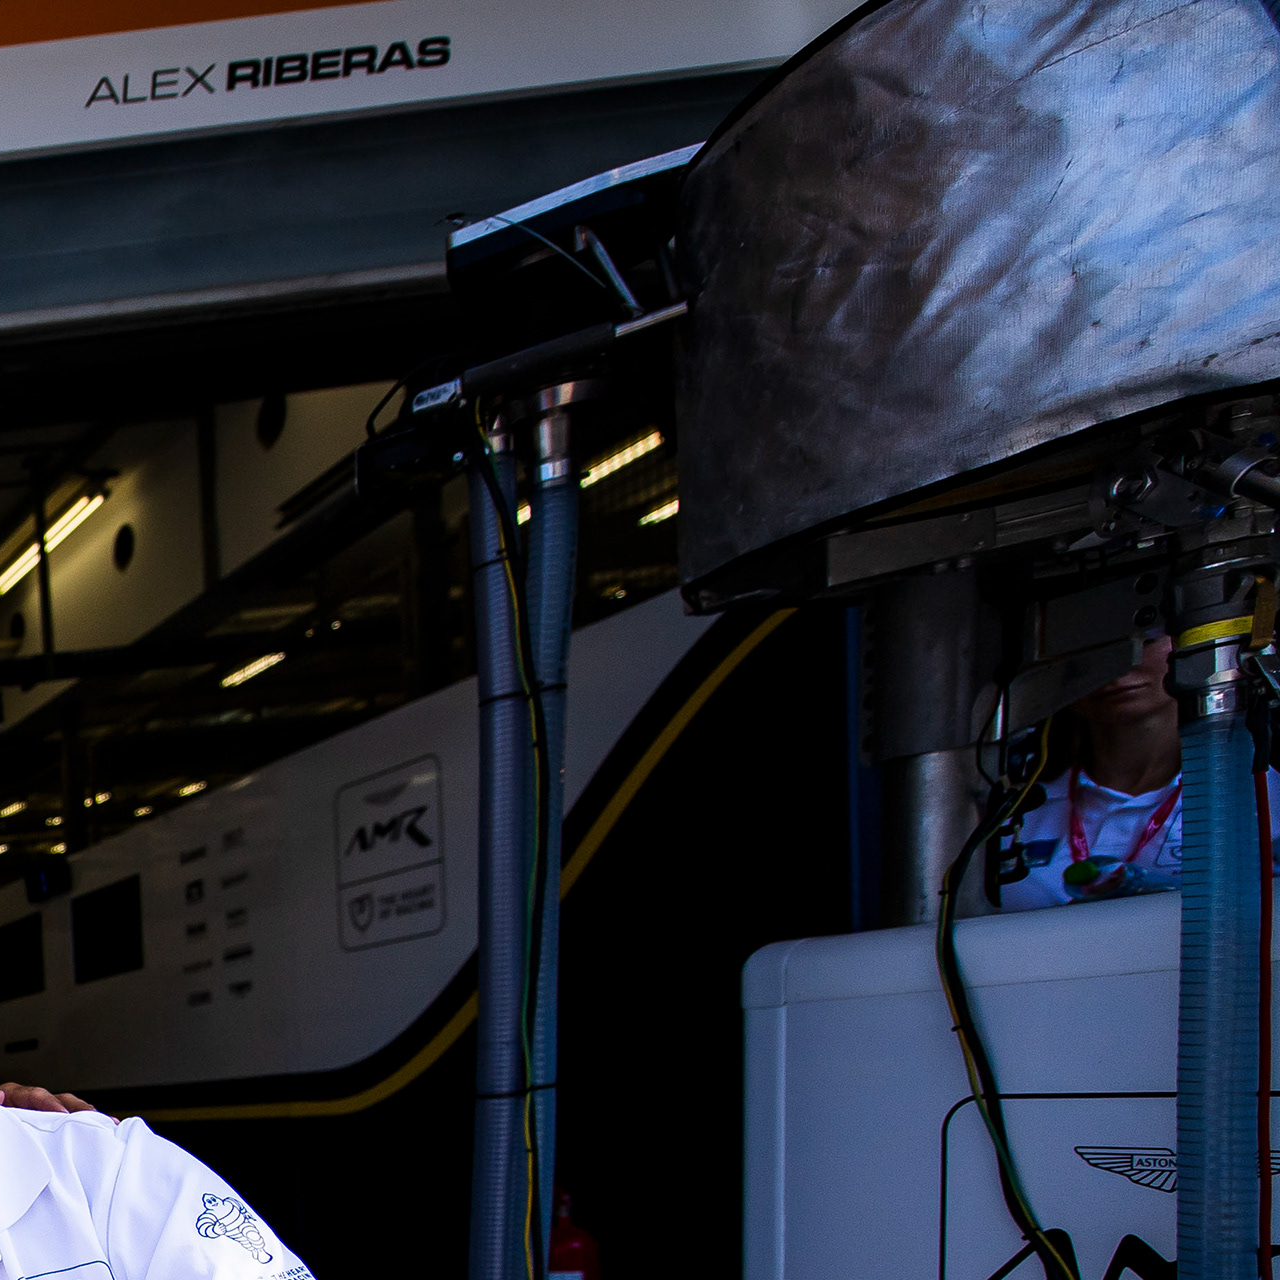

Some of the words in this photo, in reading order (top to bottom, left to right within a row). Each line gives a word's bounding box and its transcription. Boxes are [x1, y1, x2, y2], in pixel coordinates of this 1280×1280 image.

[84, 64, 217, 108] ALEX
[224, 34, 453, 92] RIBERAS
[286, 1265, 307, 1277] HEAR
